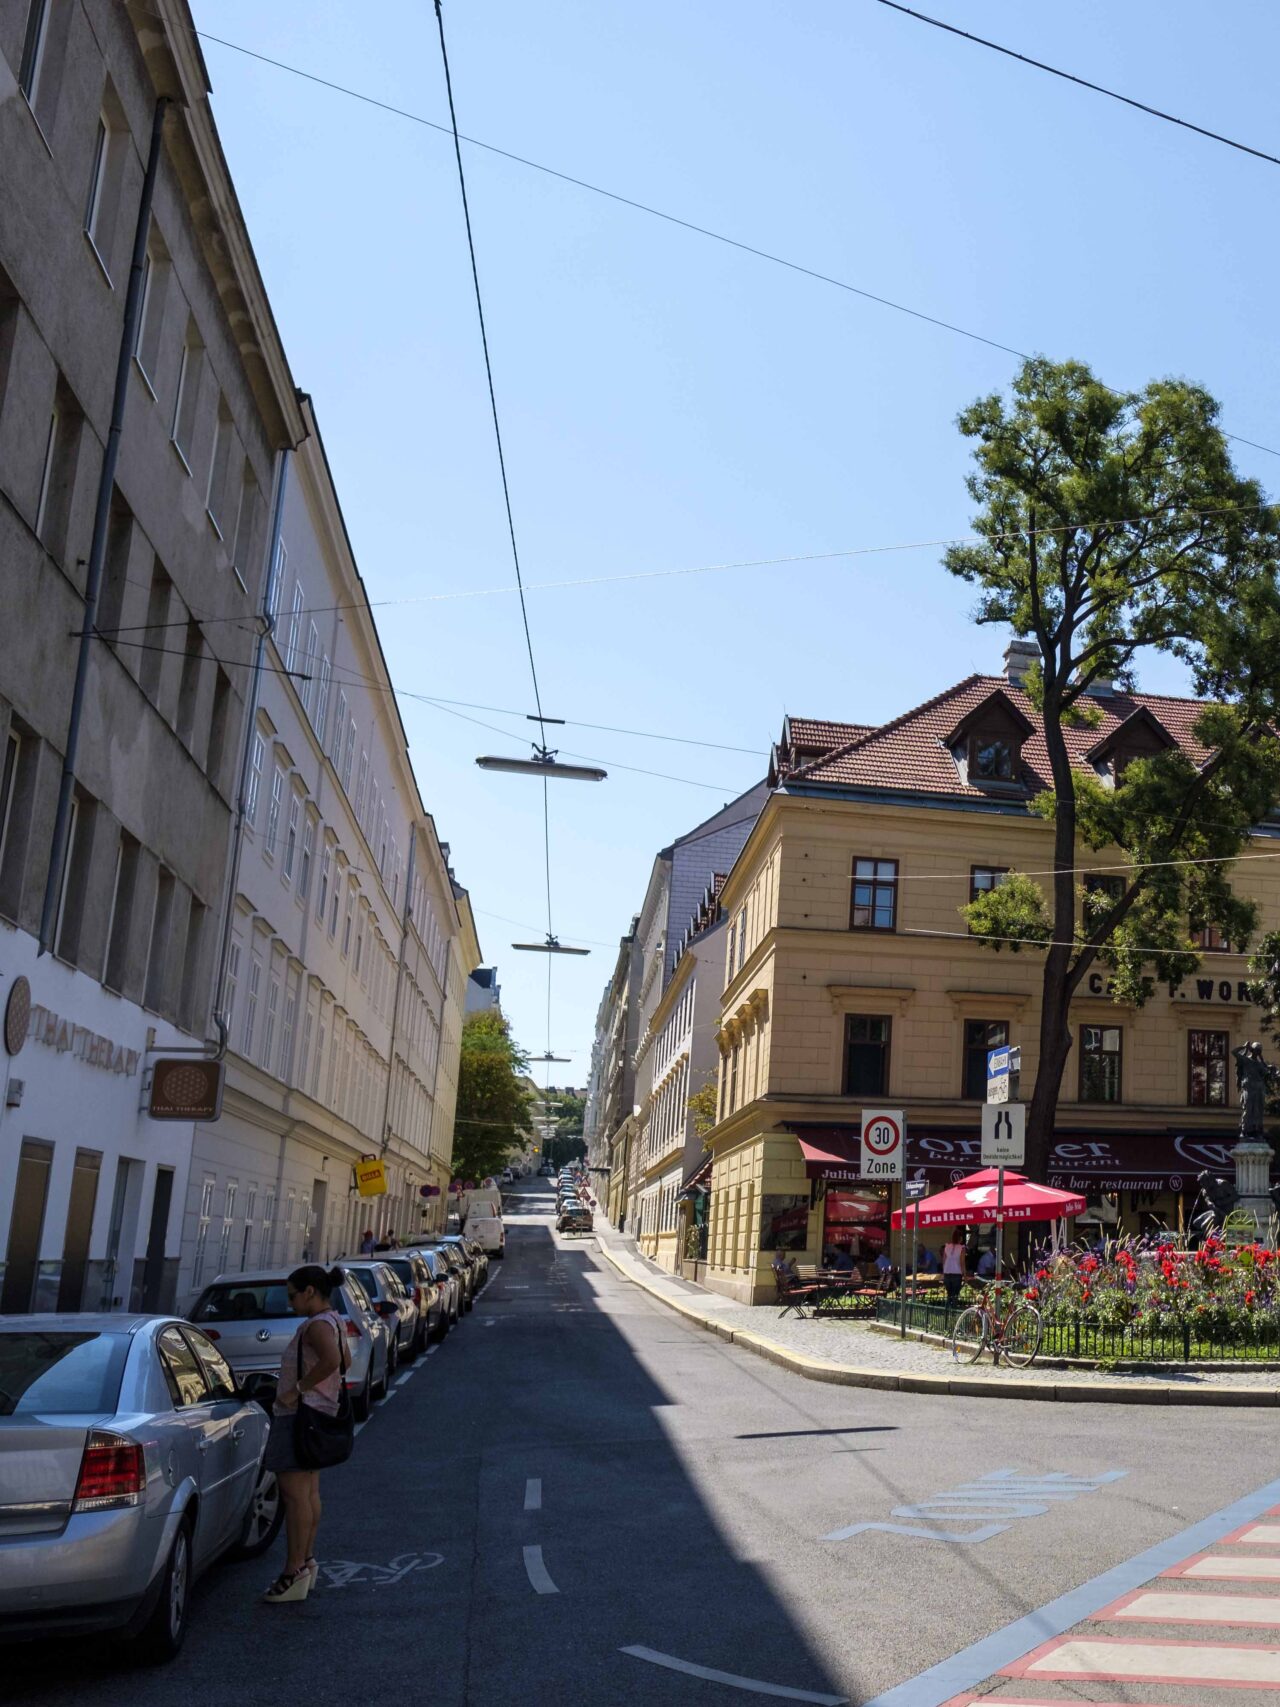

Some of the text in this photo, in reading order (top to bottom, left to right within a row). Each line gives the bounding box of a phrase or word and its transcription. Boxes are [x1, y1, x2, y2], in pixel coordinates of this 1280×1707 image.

[875, 1127, 890, 1145] 30
[867, 1159, 896, 1174] Zone
[1100, 1178, 1164, 1190] restaurant
[922, 1213, 974, 1225] Julius
